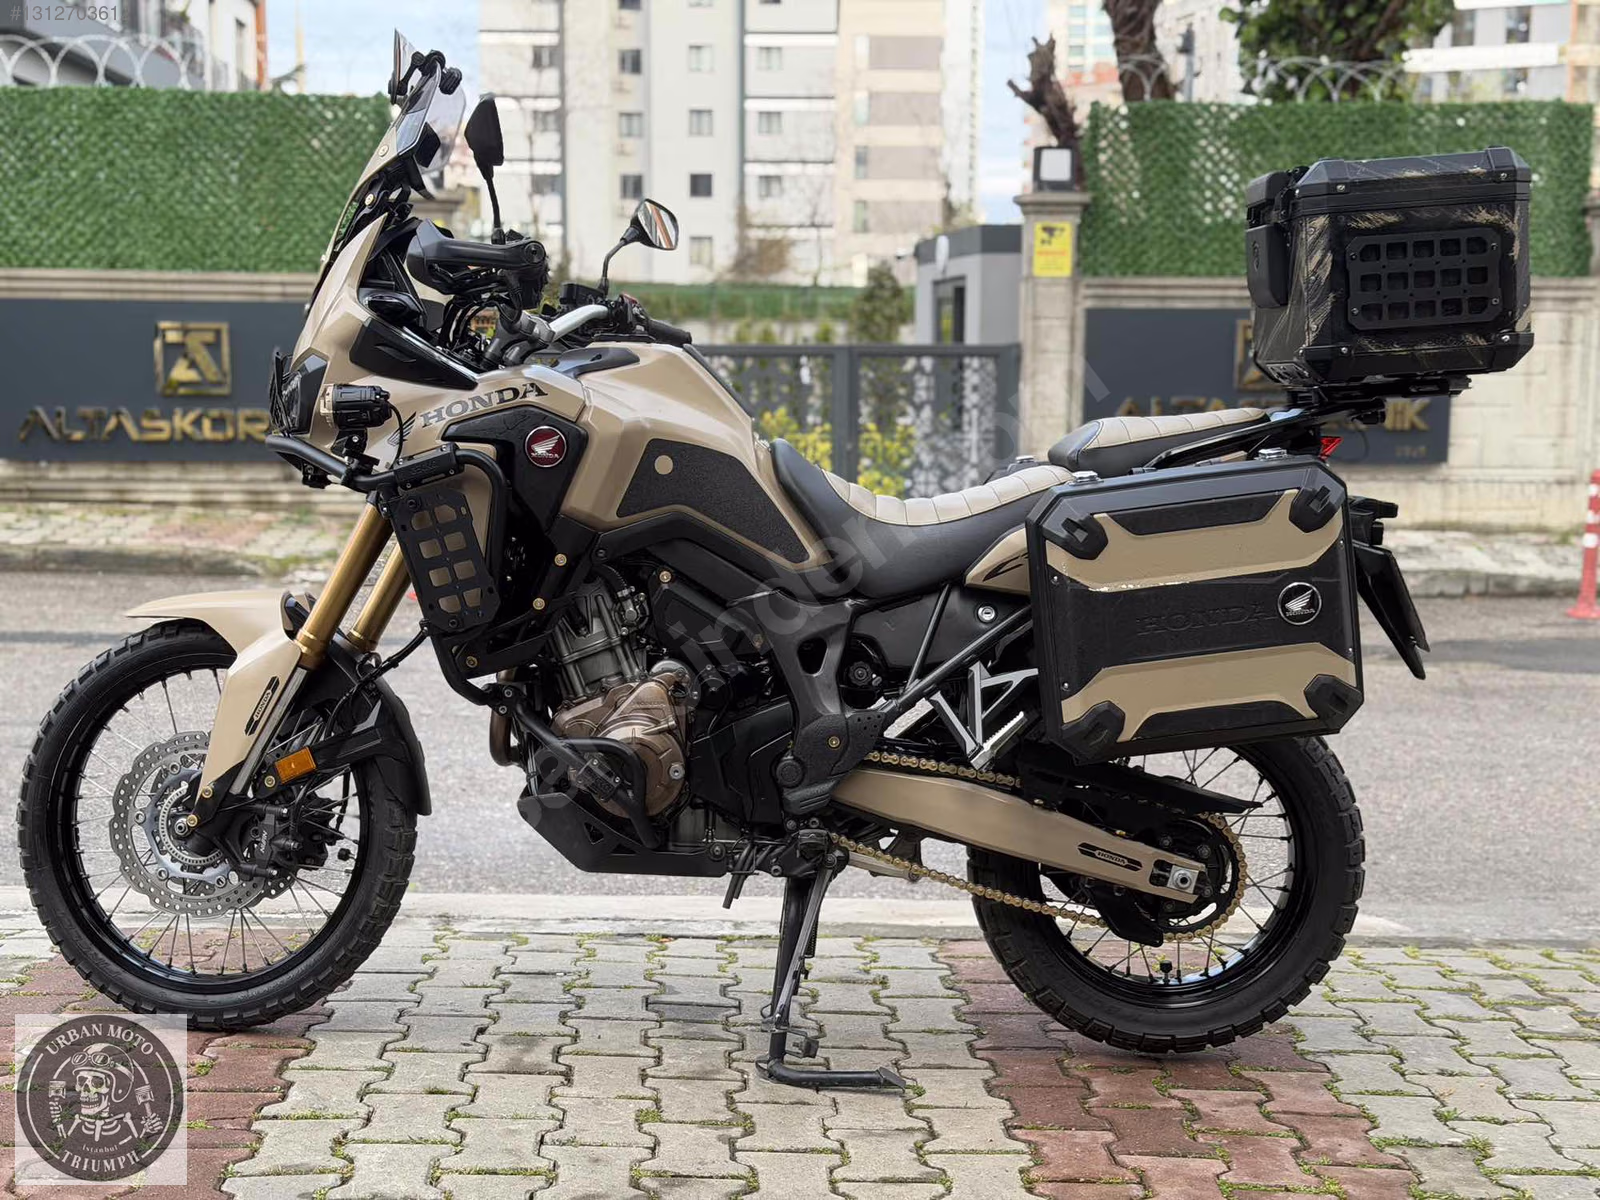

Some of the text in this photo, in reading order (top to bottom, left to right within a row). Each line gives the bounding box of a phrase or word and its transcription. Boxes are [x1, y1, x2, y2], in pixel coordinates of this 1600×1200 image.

[420, 382, 548, 428] HONDA
[531, 451, 559, 460] HONDA
[1136, 603, 1278, 636] HONDA
[1286, 608, 1316, 617] HONDA
[255, 691, 272, 719] HONDA
[1097, 851, 1126, 865] HONDA
